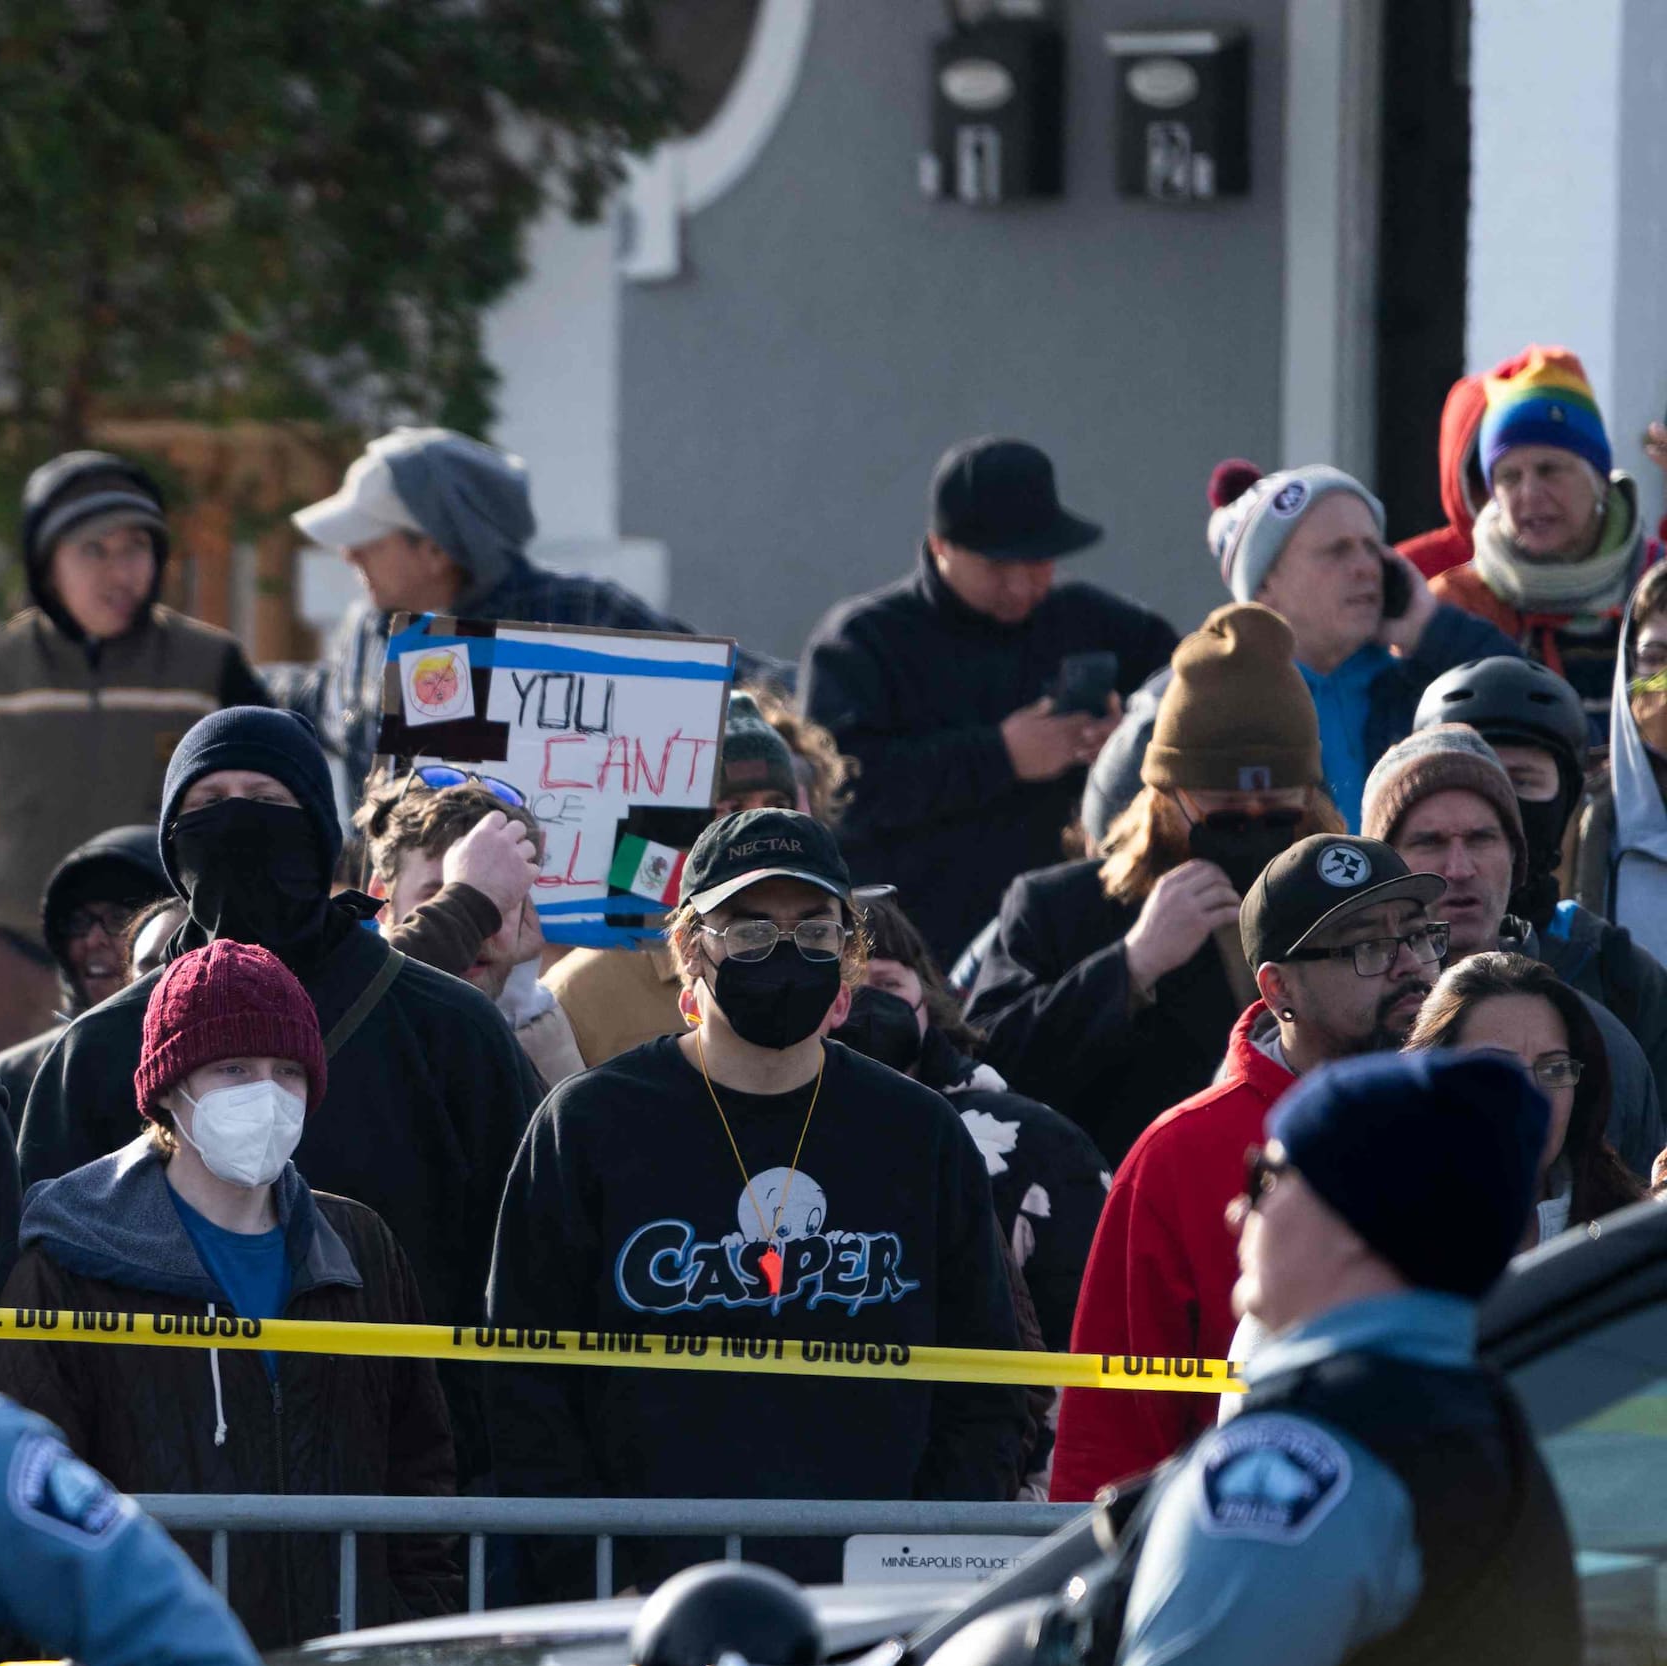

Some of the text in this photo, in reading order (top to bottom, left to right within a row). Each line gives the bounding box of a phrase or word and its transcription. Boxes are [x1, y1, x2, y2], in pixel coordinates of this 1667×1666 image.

[512, 671, 614, 734] YOU
[729, 838, 804, 860] NECTAR
[614, 1218, 920, 1316] CASPER
[881, 1556, 963, 1569] MINNEAPOLIS
[966, 1557, 1009, 1569] POLICE
